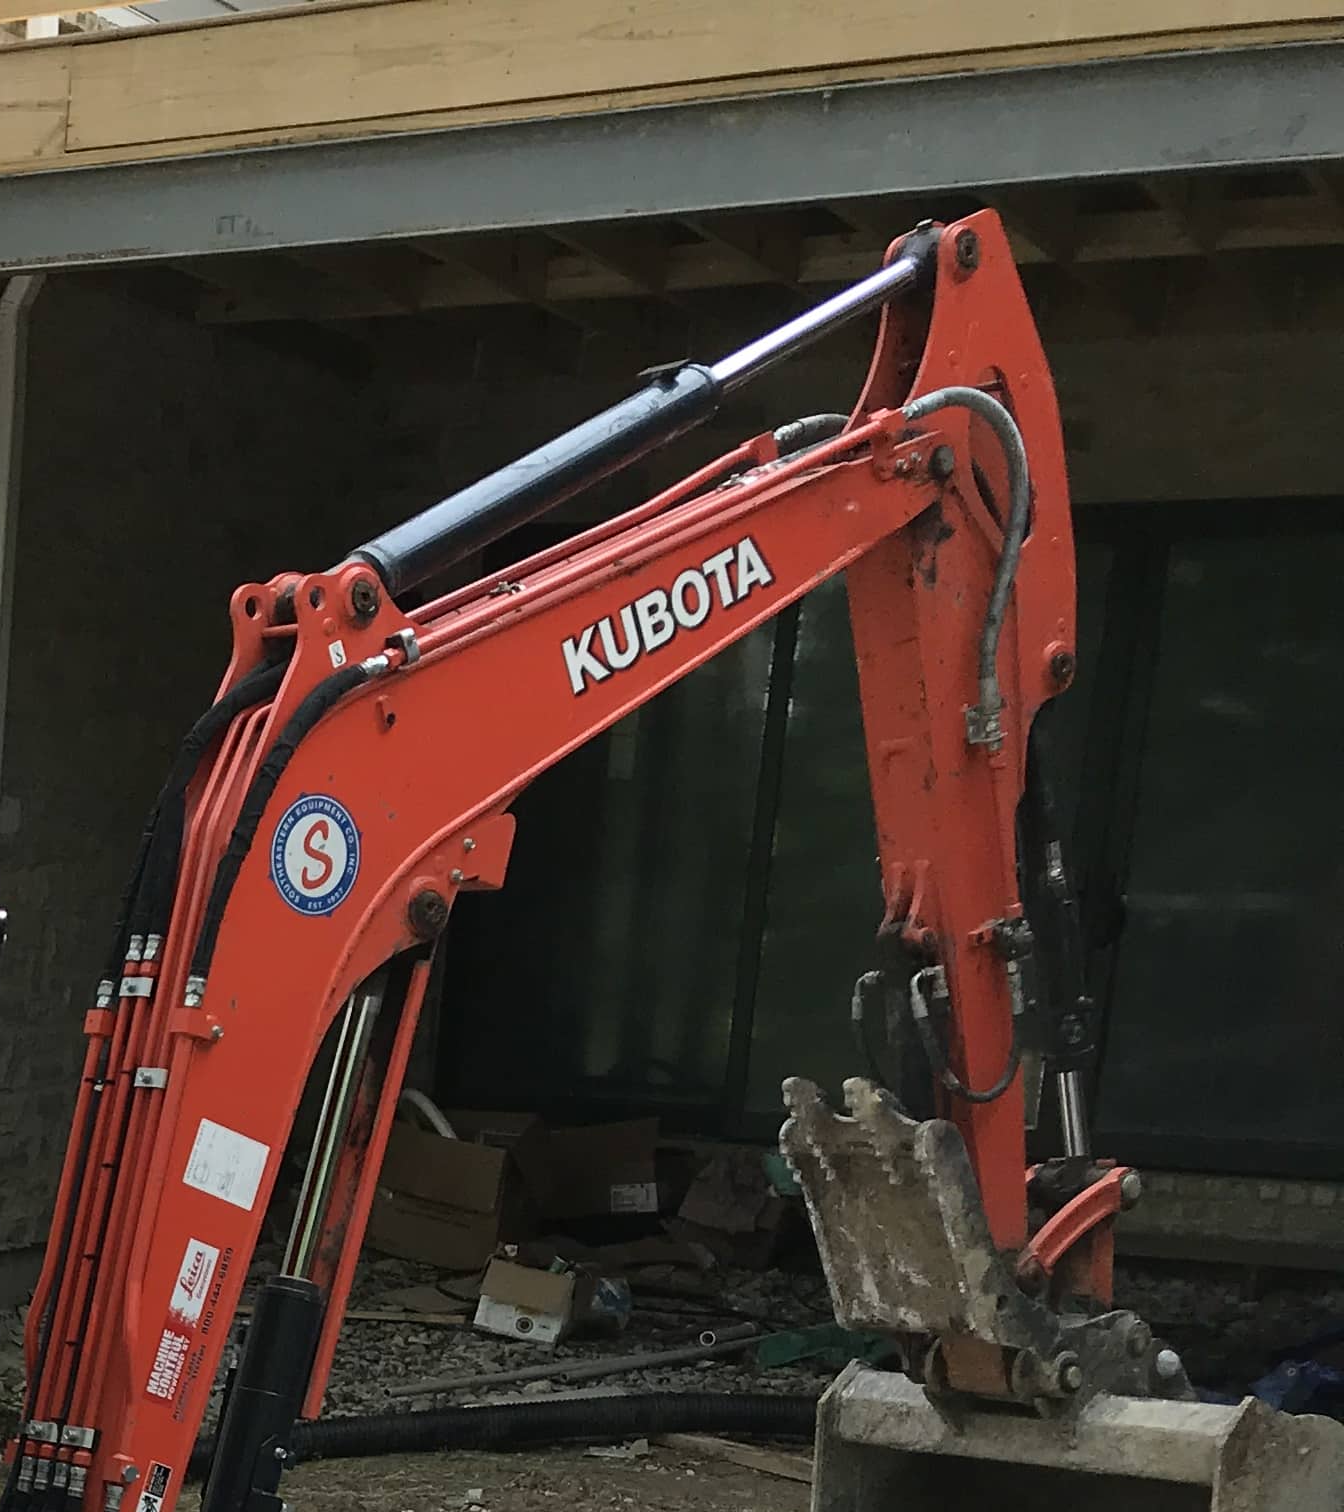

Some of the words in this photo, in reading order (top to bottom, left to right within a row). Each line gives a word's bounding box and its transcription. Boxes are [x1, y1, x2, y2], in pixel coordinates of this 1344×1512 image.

[561, 536, 773, 695] KUBOTA
[275, 816, 300, 902] SOUTHEASTERN
[294, 800, 347, 824] EQUIPMENT
[301, 819, 333, 890] S
[179, 1250, 206, 1301] Leica
[146, 1328, 175, 1395] MACHINE
[156, 1334, 185, 1399] CONTROL
[167, 1354, 185, 1400] POWERED
